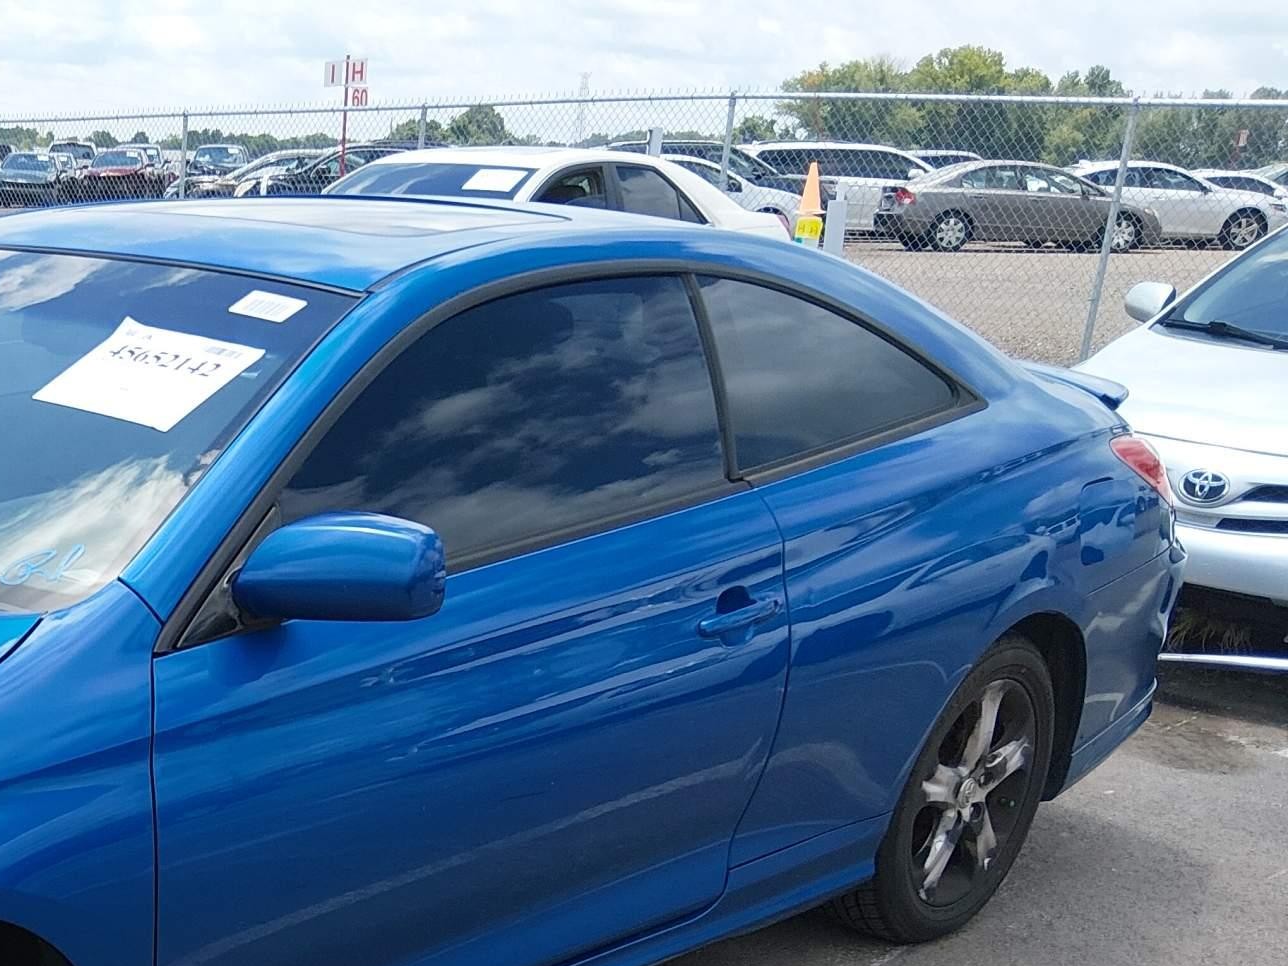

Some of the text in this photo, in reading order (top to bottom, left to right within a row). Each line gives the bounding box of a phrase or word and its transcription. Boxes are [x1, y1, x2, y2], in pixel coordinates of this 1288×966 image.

[352, 61, 364, 82] H
[352, 88, 368, 107] 60
[109, 345, 221, 377] 45652142
